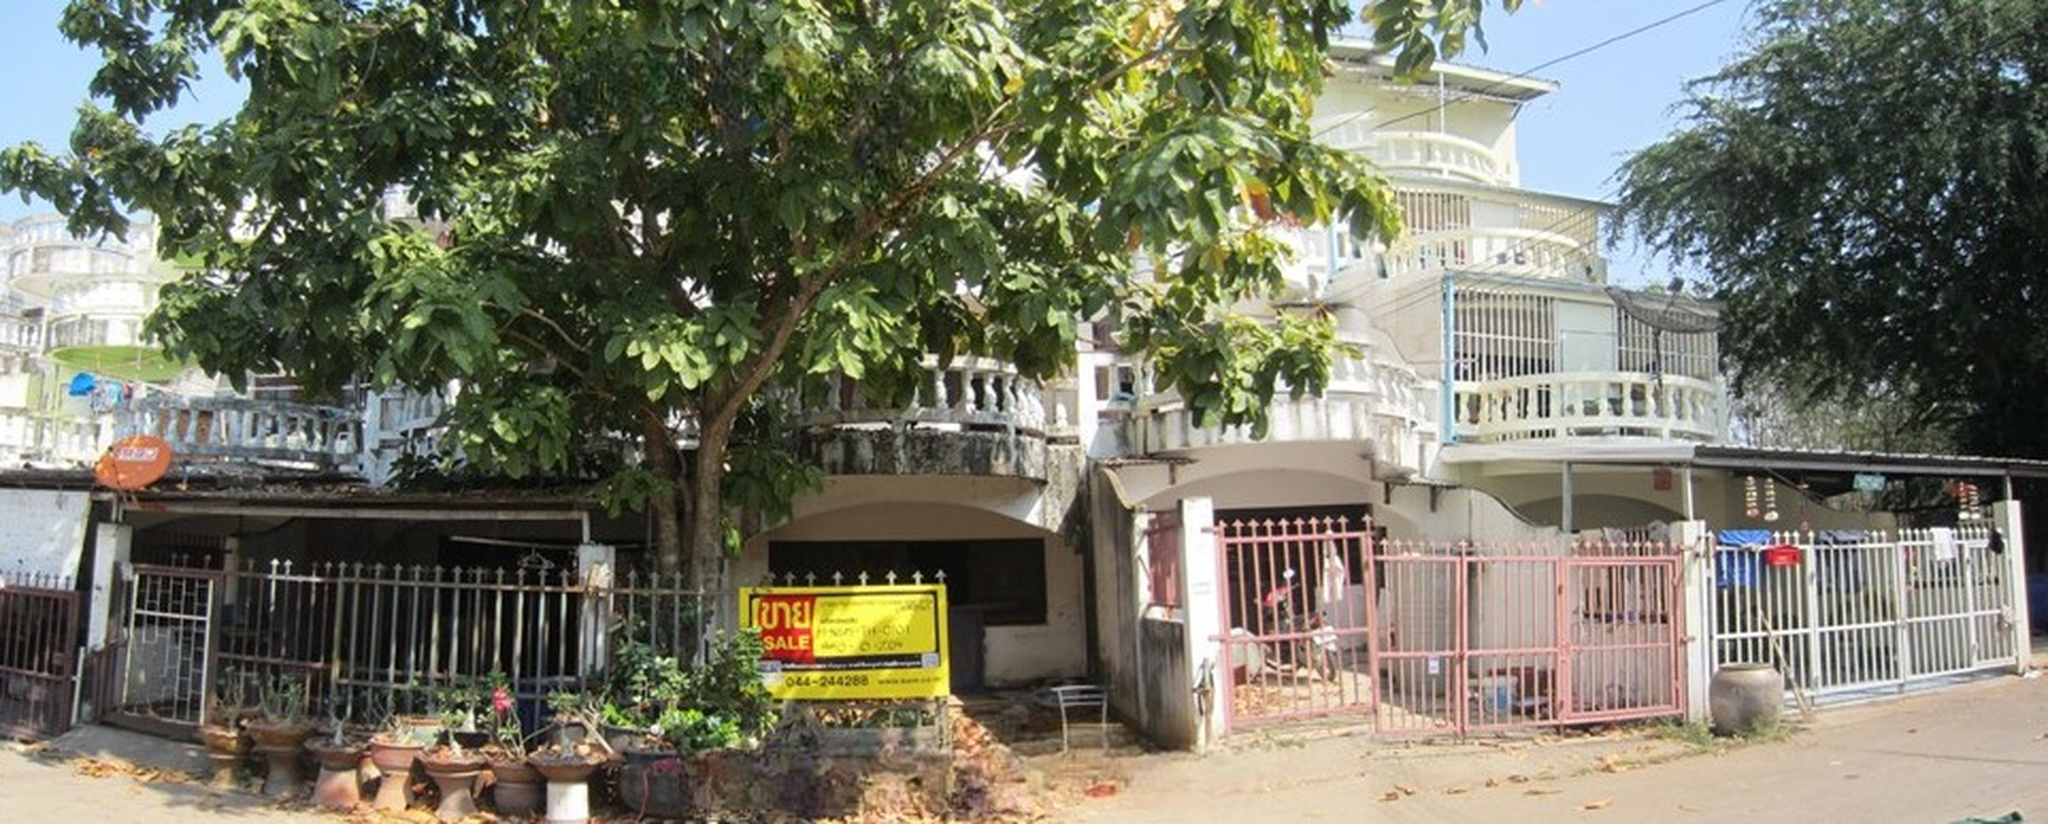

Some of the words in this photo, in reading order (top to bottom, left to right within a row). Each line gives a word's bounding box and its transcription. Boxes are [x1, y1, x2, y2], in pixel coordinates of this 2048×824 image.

[761, 601, 811, 629] ขาย
[763, 635, 810, 650] SALE
[785, 674, 869, 688] 044-244288
